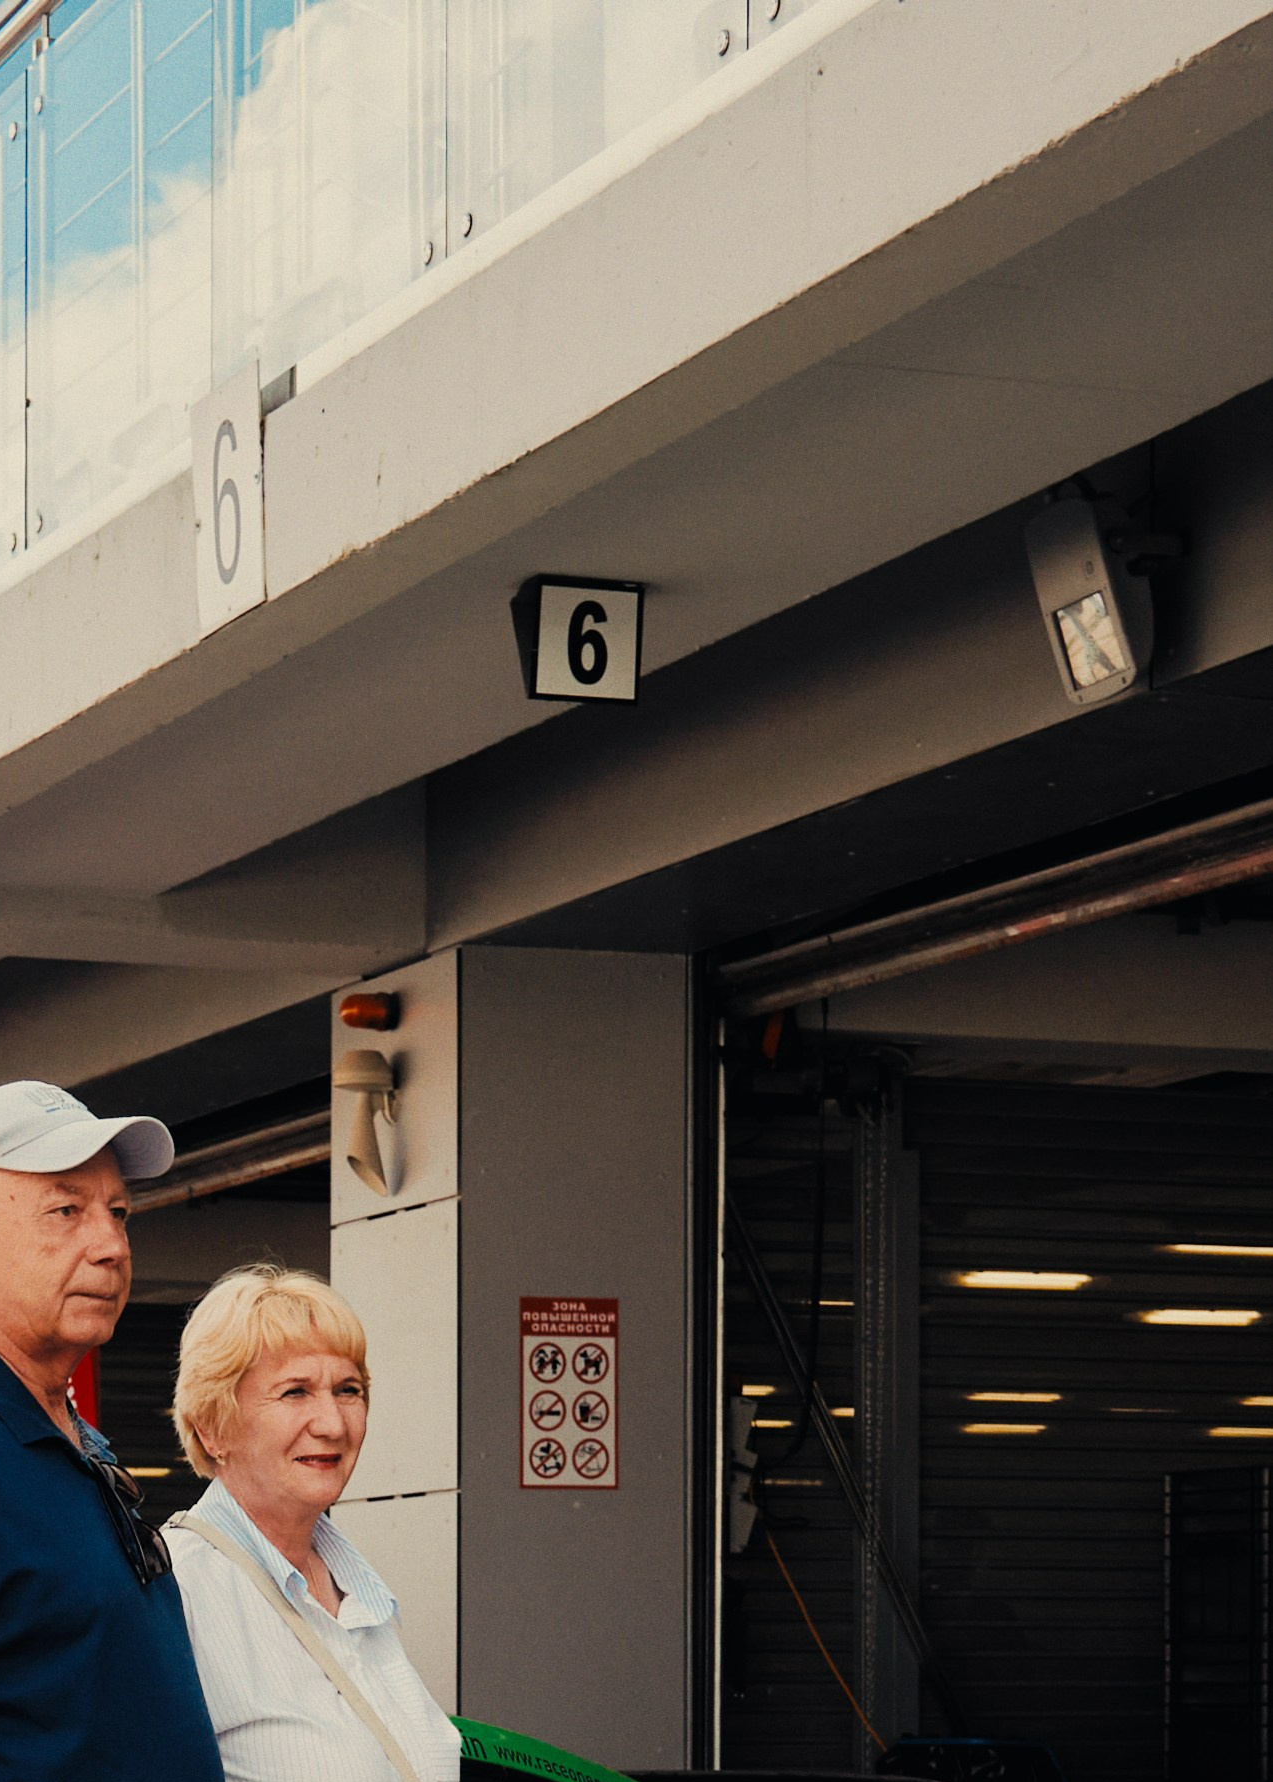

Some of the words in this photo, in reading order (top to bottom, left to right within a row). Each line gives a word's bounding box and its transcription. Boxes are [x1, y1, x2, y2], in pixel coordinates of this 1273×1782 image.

[213, 418, 241, 585] 6
[567, 599, 609, 685] 6
[552, 1301, 587, 1311] ЗОНА
[522, 1311, 616, 1323] ПОВЫШЕННОЙ
[531, 1323, 611, 1333] ОПАСНОСТИ
